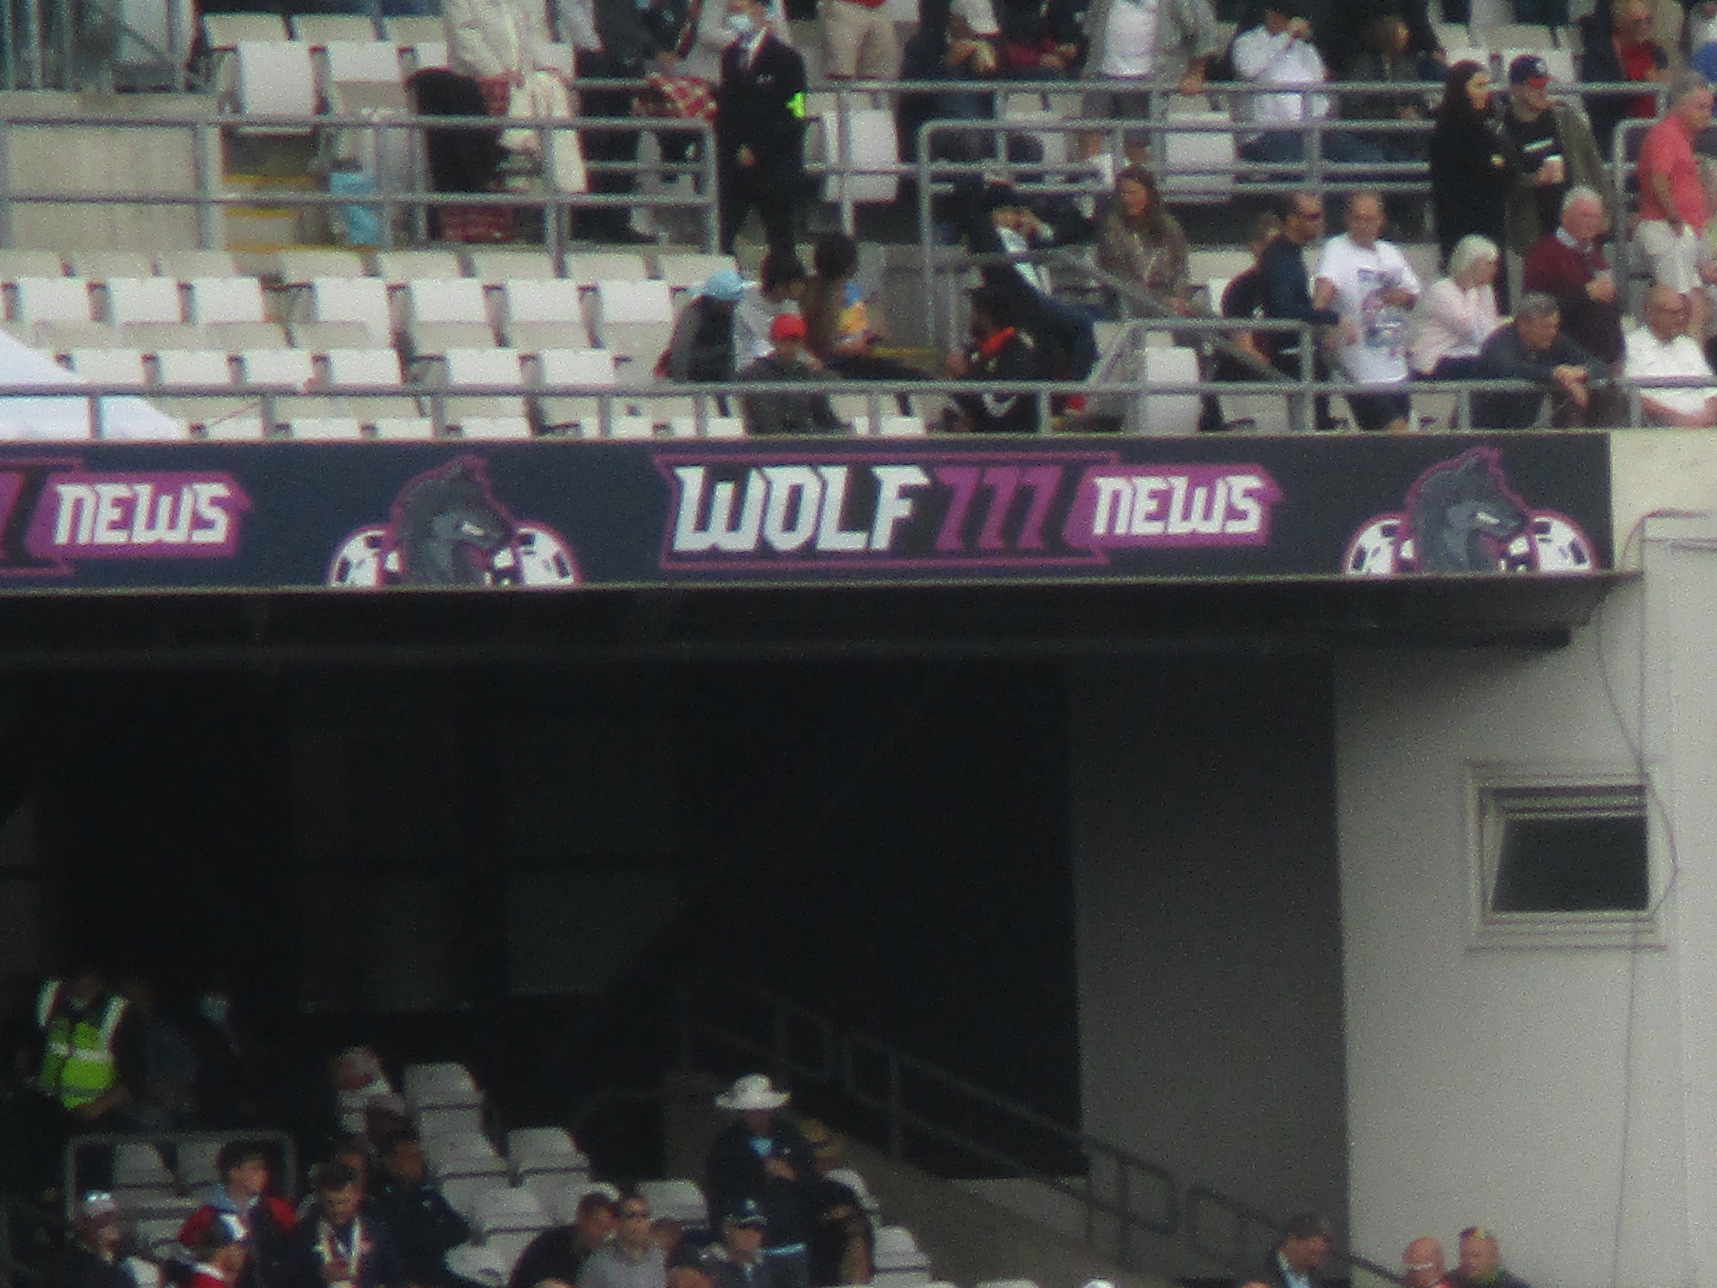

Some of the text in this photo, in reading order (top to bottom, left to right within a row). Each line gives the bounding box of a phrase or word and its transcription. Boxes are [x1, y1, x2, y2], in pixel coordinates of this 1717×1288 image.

[53, 482, 232, 546] NEWS
[671, 464, 931, 553] WOLF
[1092, 474, 1265, 536] NEWS
